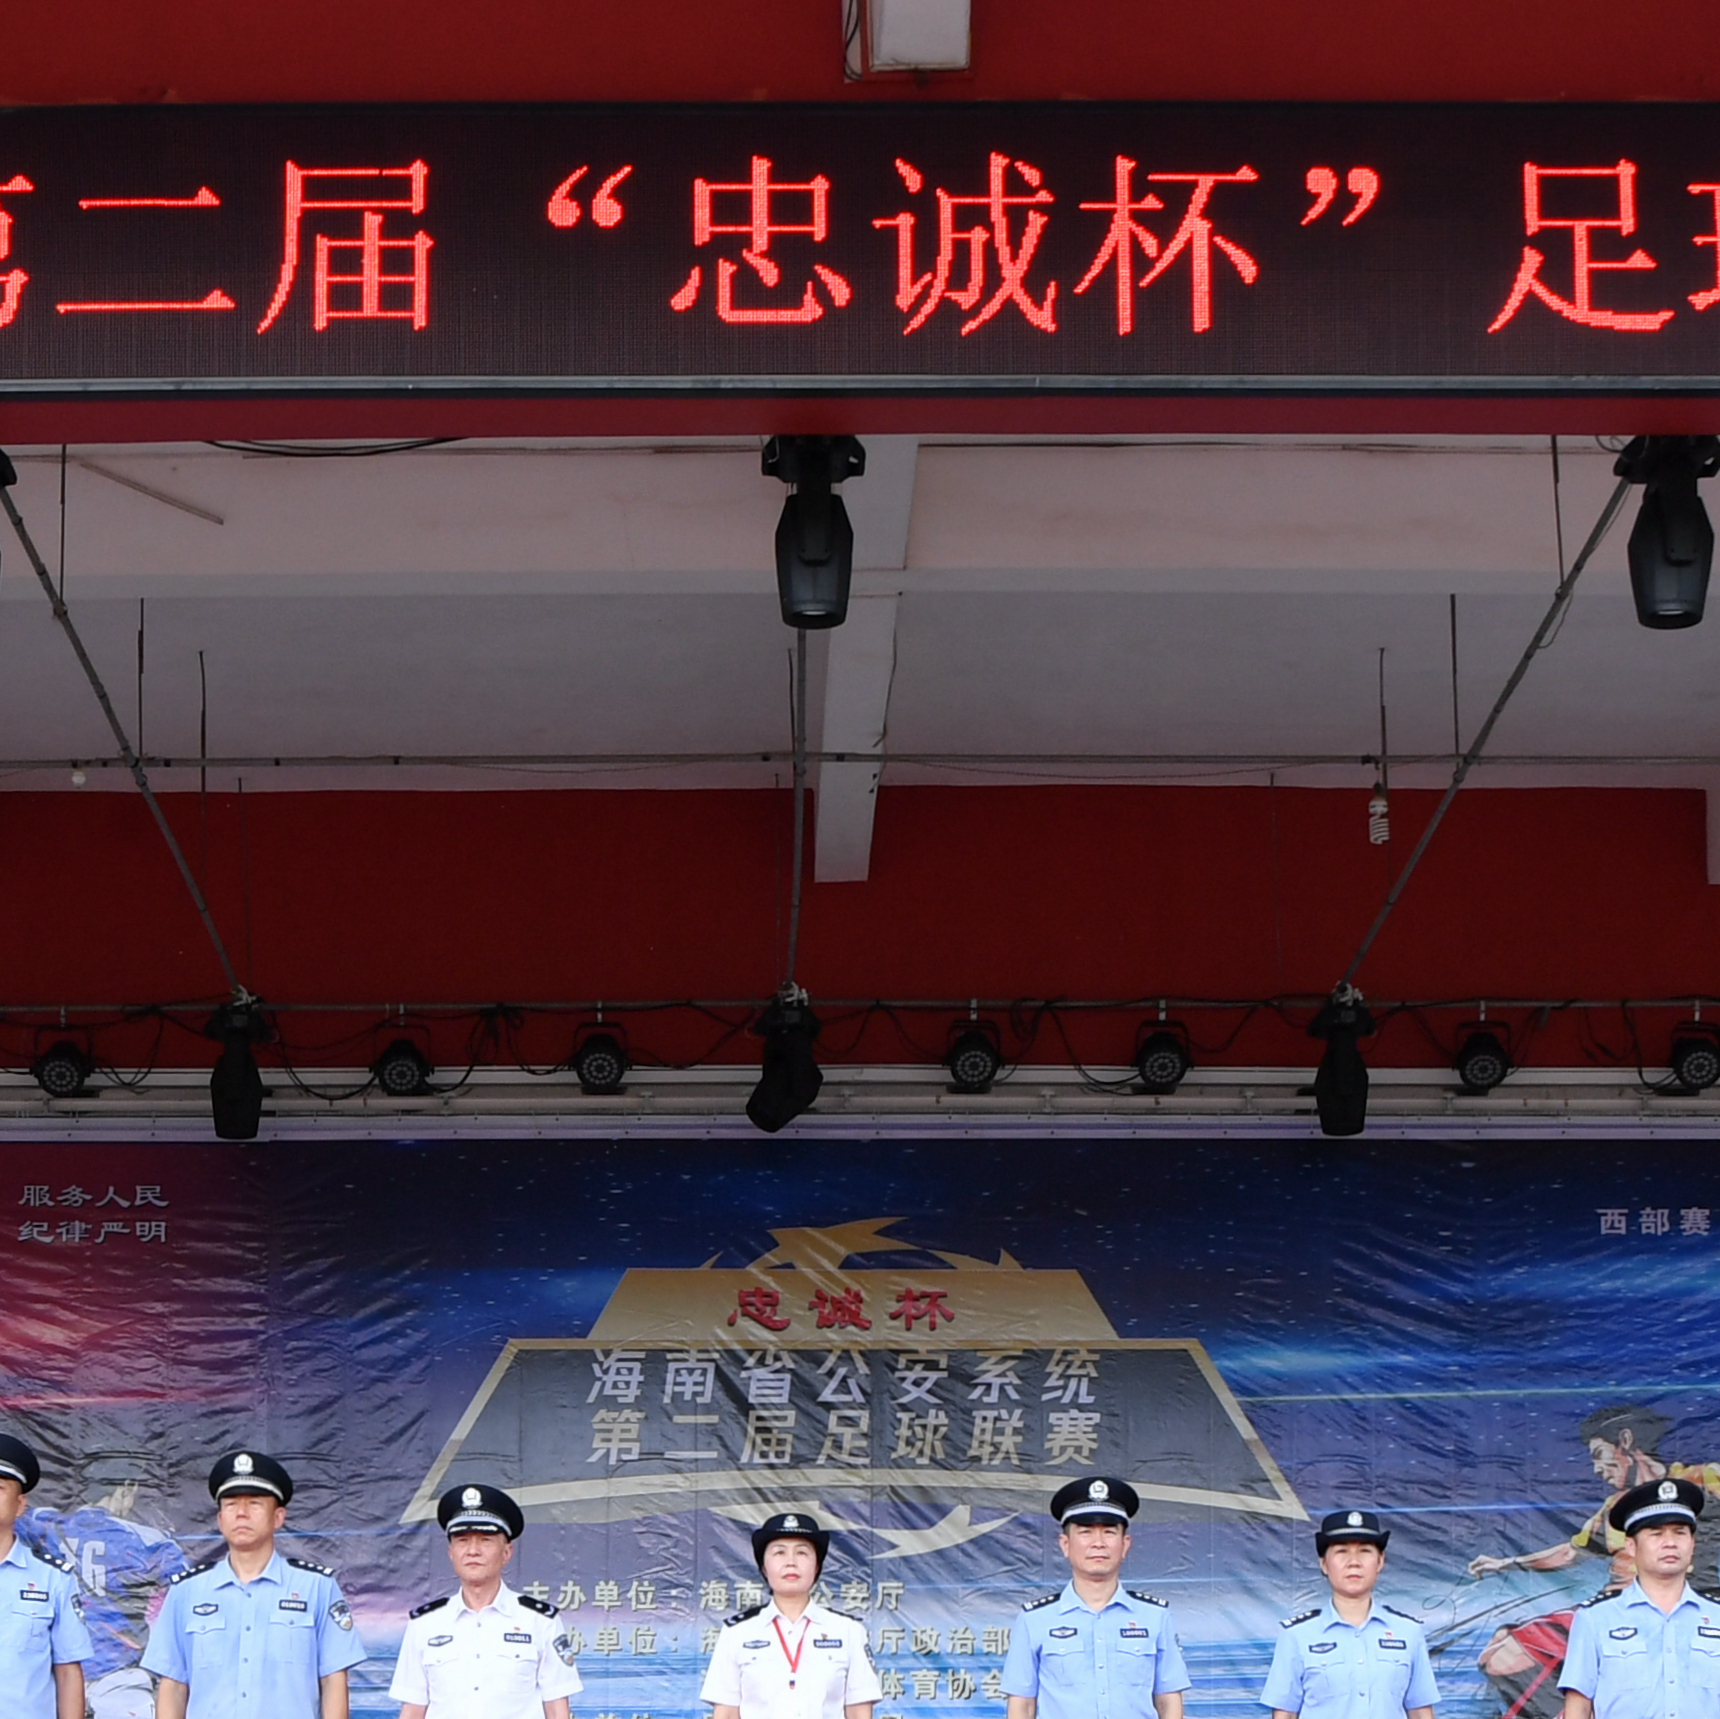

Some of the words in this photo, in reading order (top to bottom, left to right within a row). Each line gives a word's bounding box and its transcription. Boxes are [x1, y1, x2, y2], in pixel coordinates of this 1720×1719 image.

[18, 1185, 170, 1208] 服务人民
[18, 1220, 168, 1243] 纪律严明
[727, 1286, 955, 1331] 忠诚杯
[585, 1347, 1101, 1405] 海南省公安系统
[585, 1408, 1101, 1467] 第二届足球联赛
